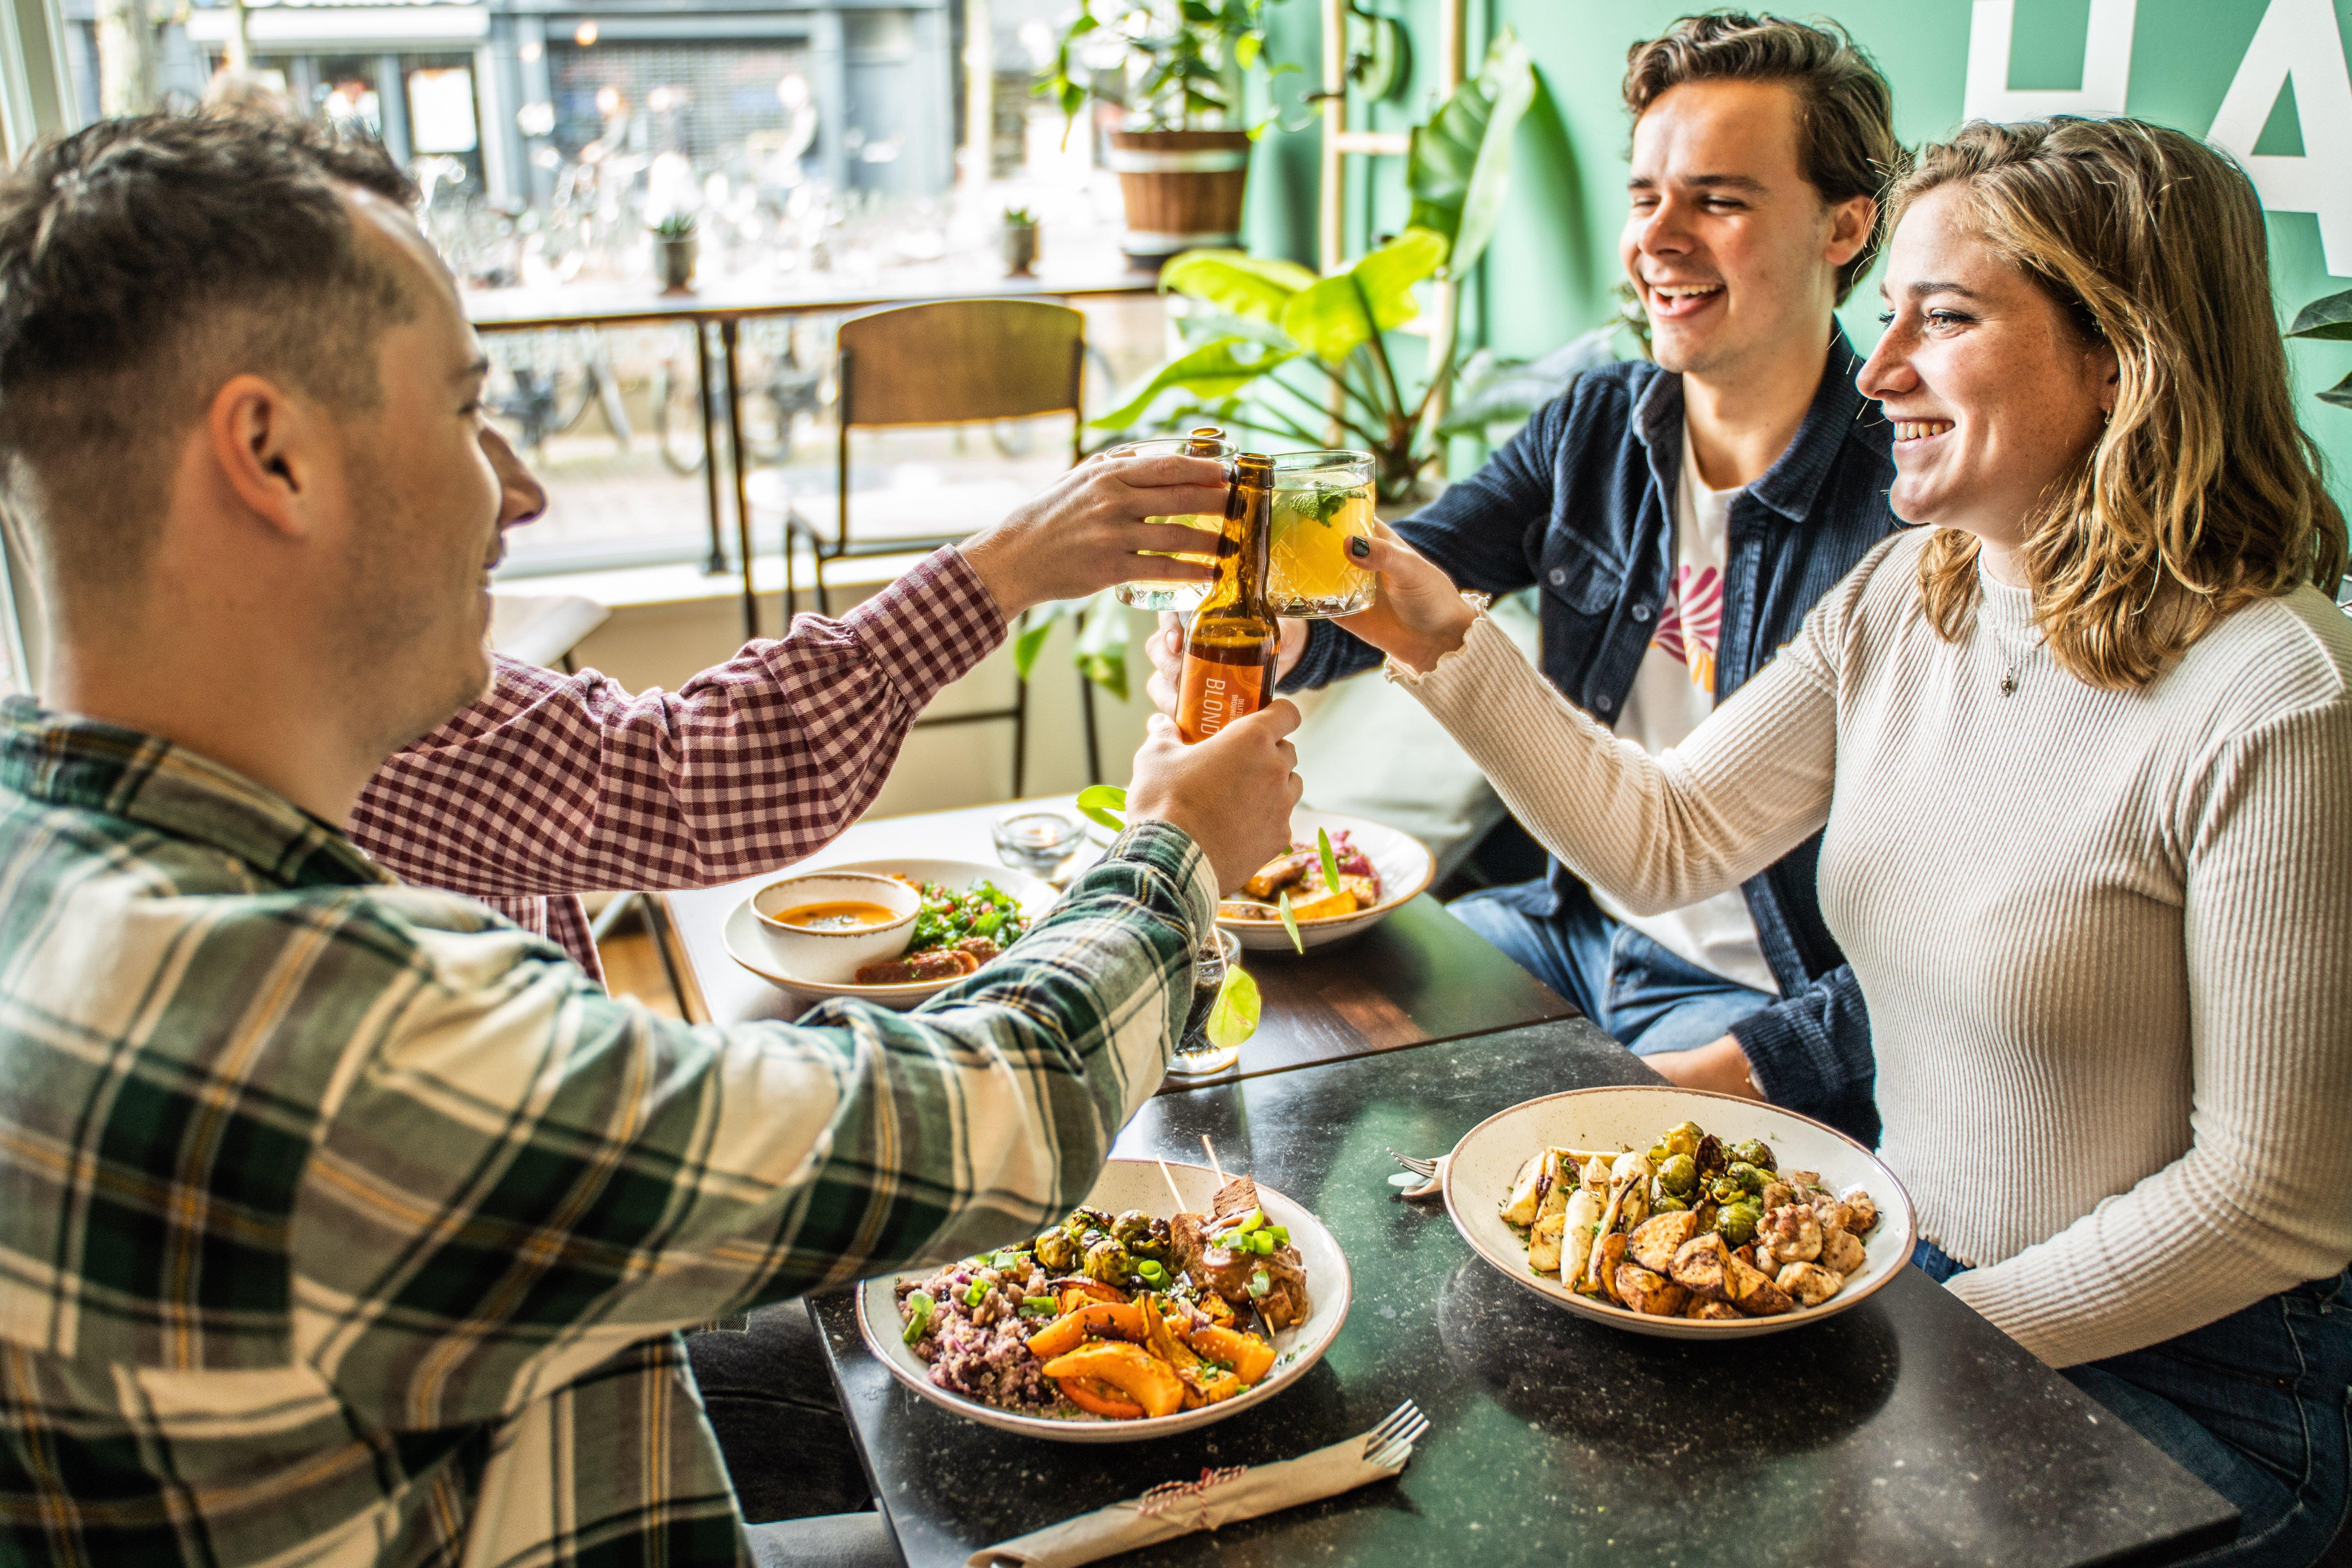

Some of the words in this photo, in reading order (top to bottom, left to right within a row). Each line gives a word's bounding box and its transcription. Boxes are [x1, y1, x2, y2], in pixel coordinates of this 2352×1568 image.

[1200, 678, 1225, 735] BLOND
[1229, 695, 1238, 723] BROUWER
[1236, 699, 1245, 719] DELFTS
